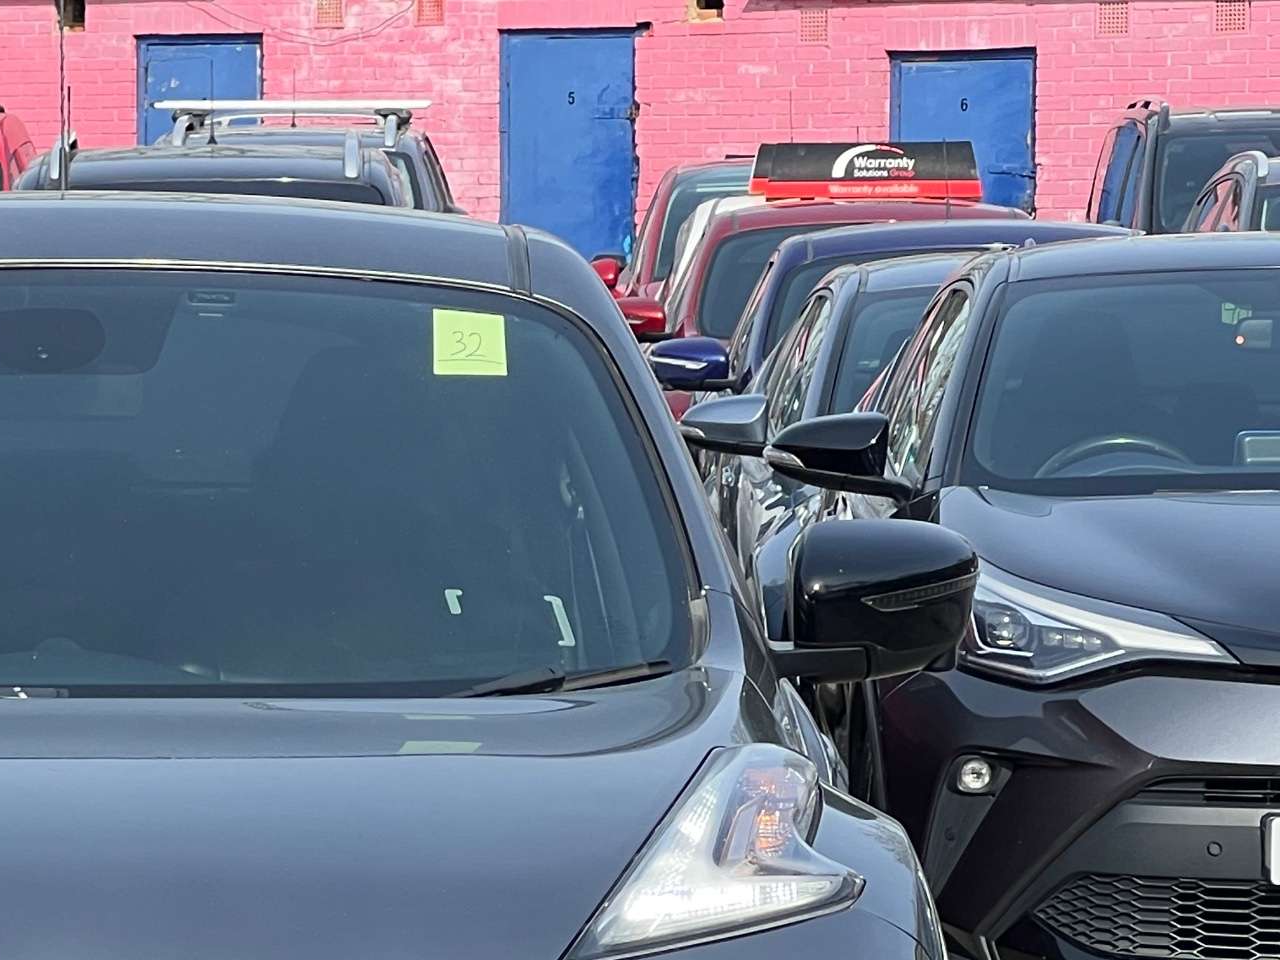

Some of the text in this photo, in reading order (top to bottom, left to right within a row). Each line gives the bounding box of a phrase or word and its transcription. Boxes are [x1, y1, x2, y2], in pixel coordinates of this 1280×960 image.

[567, 91, 575, 105] 5
[960, 97, 968, 112] 6
[853, 156, 915, 171] Warranty
[853, 169, 888, 178] Solutions
[450, 330, 488, 358] 32
